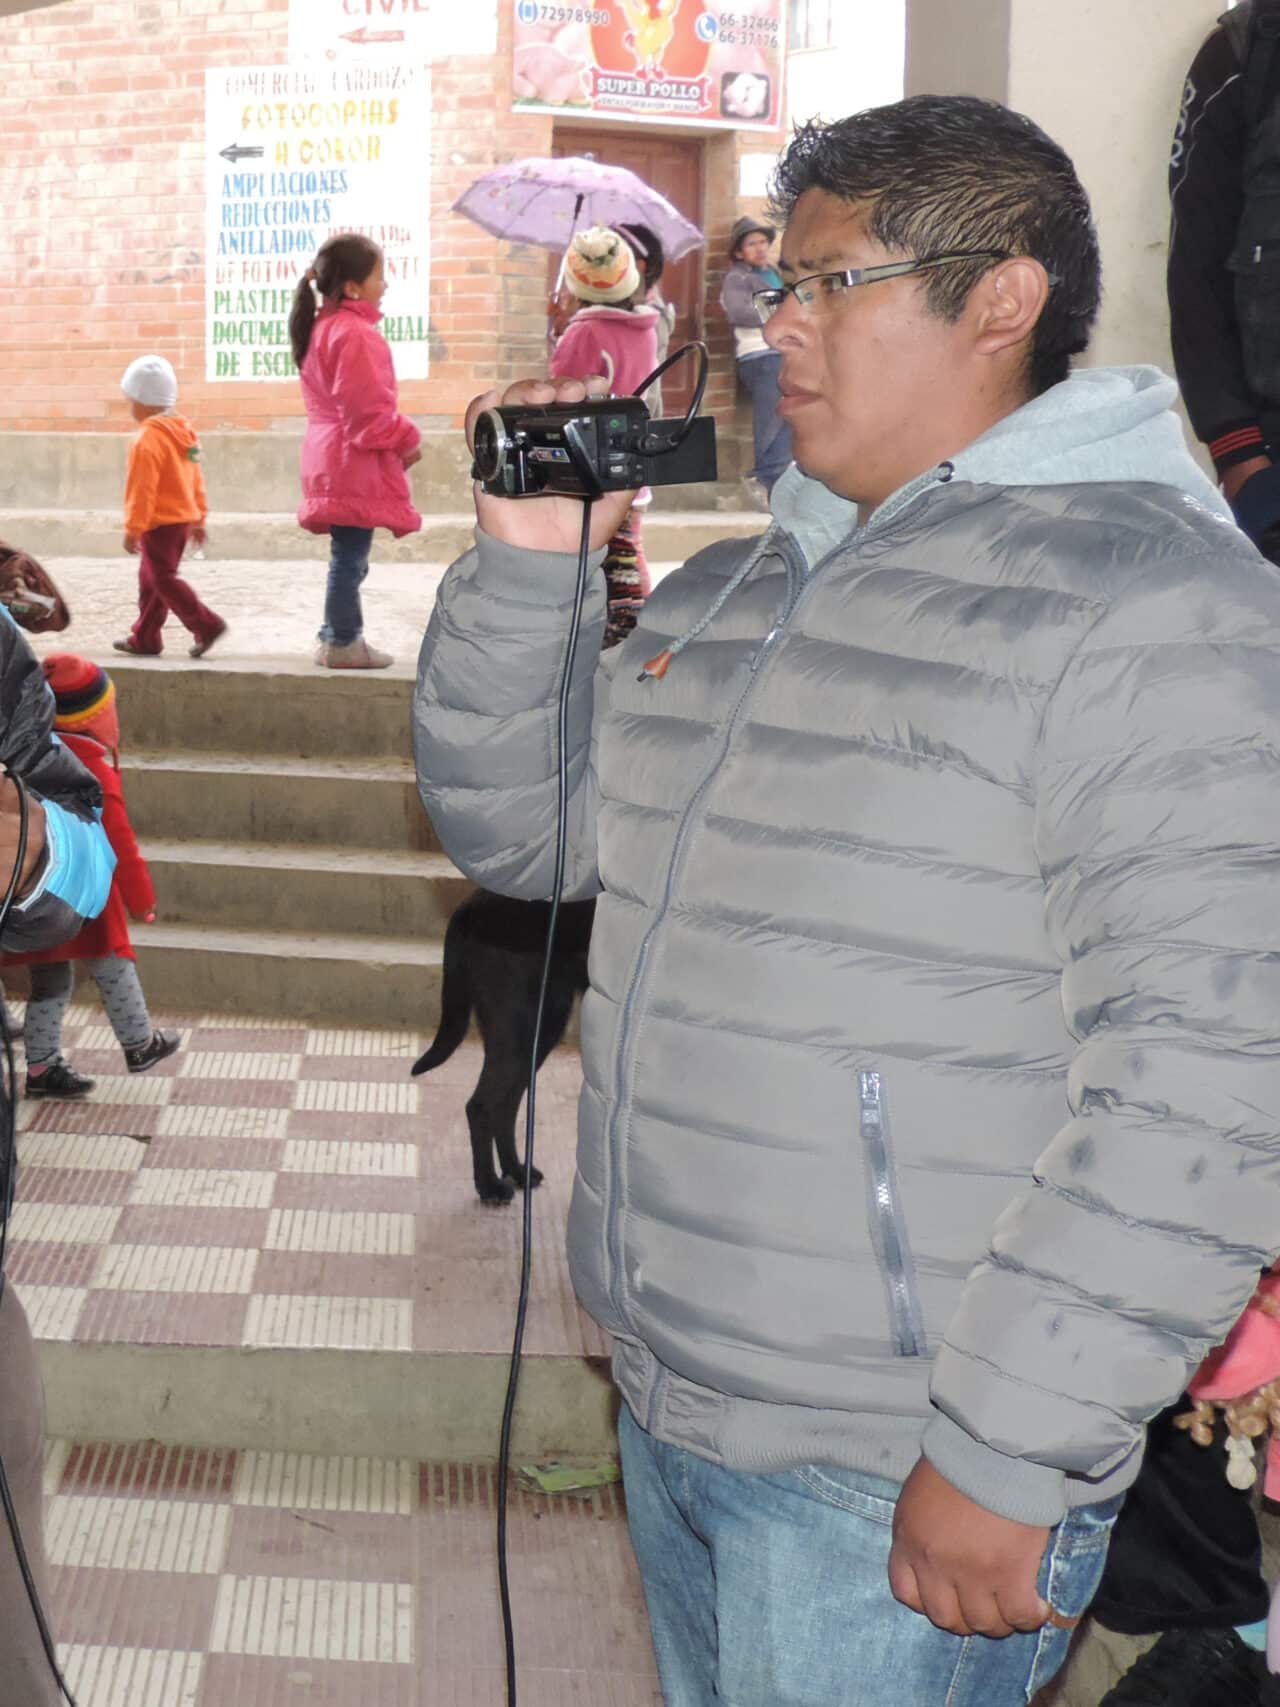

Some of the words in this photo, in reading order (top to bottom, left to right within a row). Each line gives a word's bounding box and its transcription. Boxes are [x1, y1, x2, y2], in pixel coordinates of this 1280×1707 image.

[540, 5, 609, 25] 72978990
[597, 78, 646, 96] SUPER
[650, 82, 701, 100] POLLO
[240, 98, 401, 129] FOTOCOPIAS
[221, 169, 349, 199] AMPLIACIONES
[221, 198, 332, 228] REDUCCIONES
[216, 228, 316, 256] ANILLADOS
[242, 259, 298, 284] FOTOS
[213, 288, 296, 315] PLASTIF
[212, 320, 292, 346] DOCUME
[216, 351, 240, 377] DE
